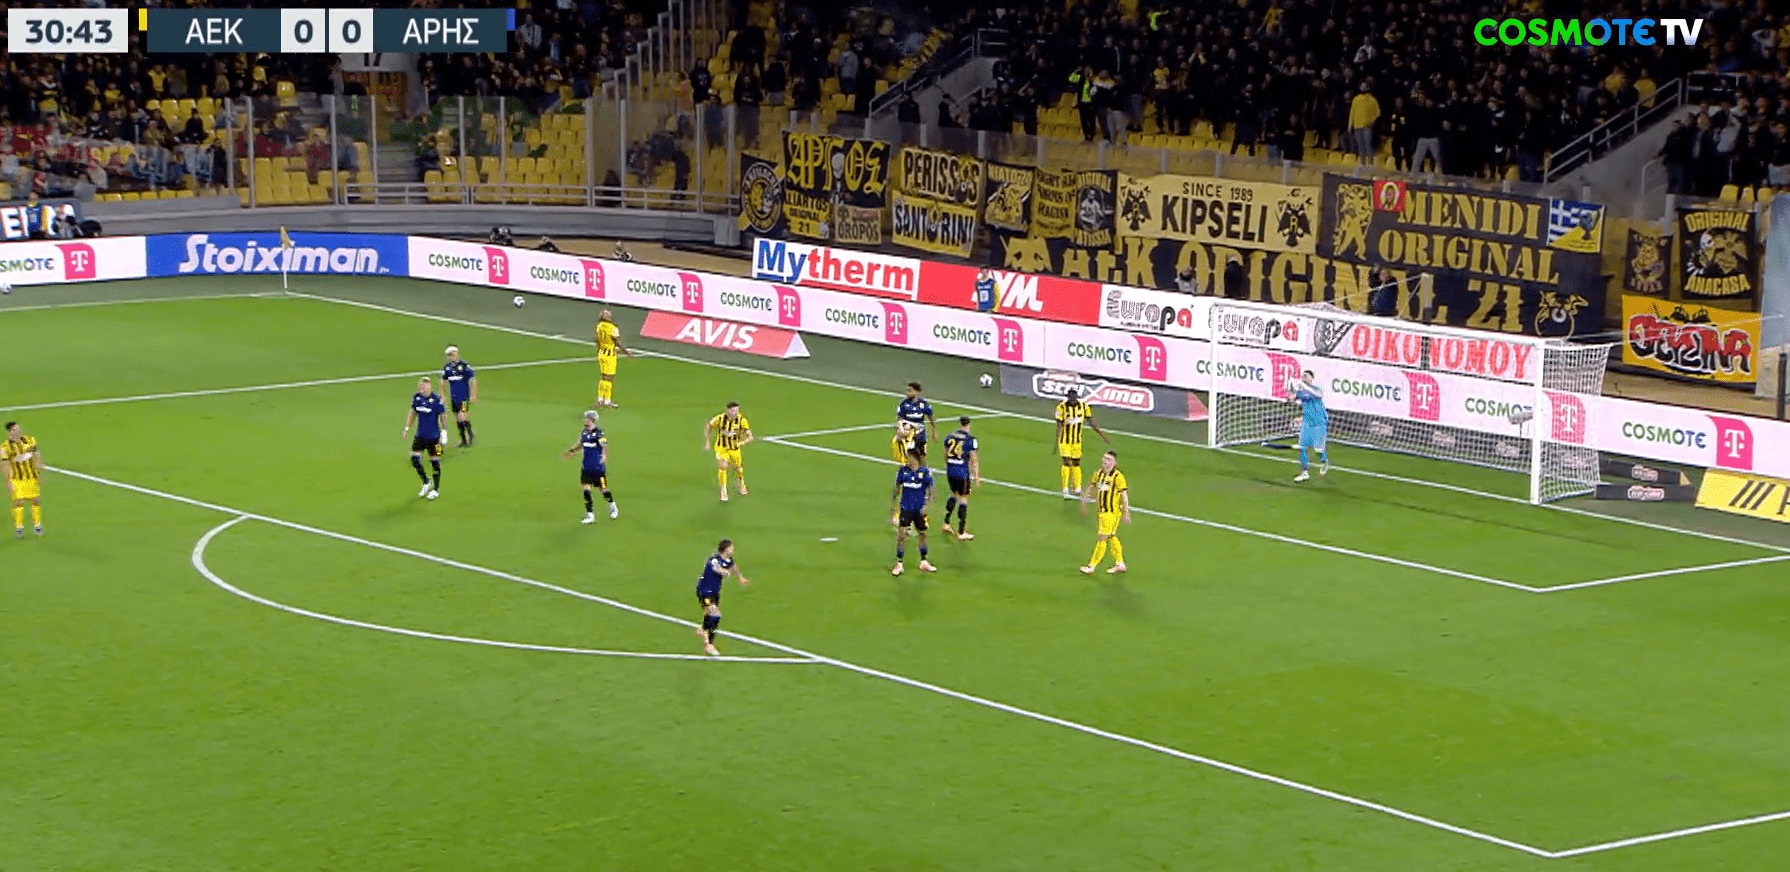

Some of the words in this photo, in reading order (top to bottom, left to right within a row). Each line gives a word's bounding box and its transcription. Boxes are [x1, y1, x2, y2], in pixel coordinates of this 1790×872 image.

[1182, 181, 1222, 198] SINCE
[1230, 186, 1253, 201] 1989
[1161, 194, 1268, 243] KIPSELI
[1396, 190, 1541, 240] MENIDI
[1684, 211, 1750, 234] ORIGINAL
[798, 222, 811, 234] 21
[837, 221, 880, 241] OROPOS
[179, 234, 379, 273] Stoiximan
[429, 254, 482, 271] COSMOTE
[1378, 230, 1560, 285] ORIGINAL
[531, 266, 580, 285] COSMOTE
[758, 240, 914, 292] Mytherm
[627, 280, 677, 299] COSMOTE
[1683, 274, 1752, 296] ANACASA
[721, 292, 772, 311] COSMOTE
[1107, 290, 1192, 331] Europa
[1466, 279, 1524, 332] 21
[825, 309, 879, 328] COSMOTE
[675, 318, 758, 349] AVIS
[933, 324, 991, 345] COSMOTE
[1068, 342, 1132, 363] COSMOTE
[1332, 378, 1402, 401] COSMOTE
[1623, 422, 1707, 449] COSMOTE
[947, 438, 963, 457] 24
